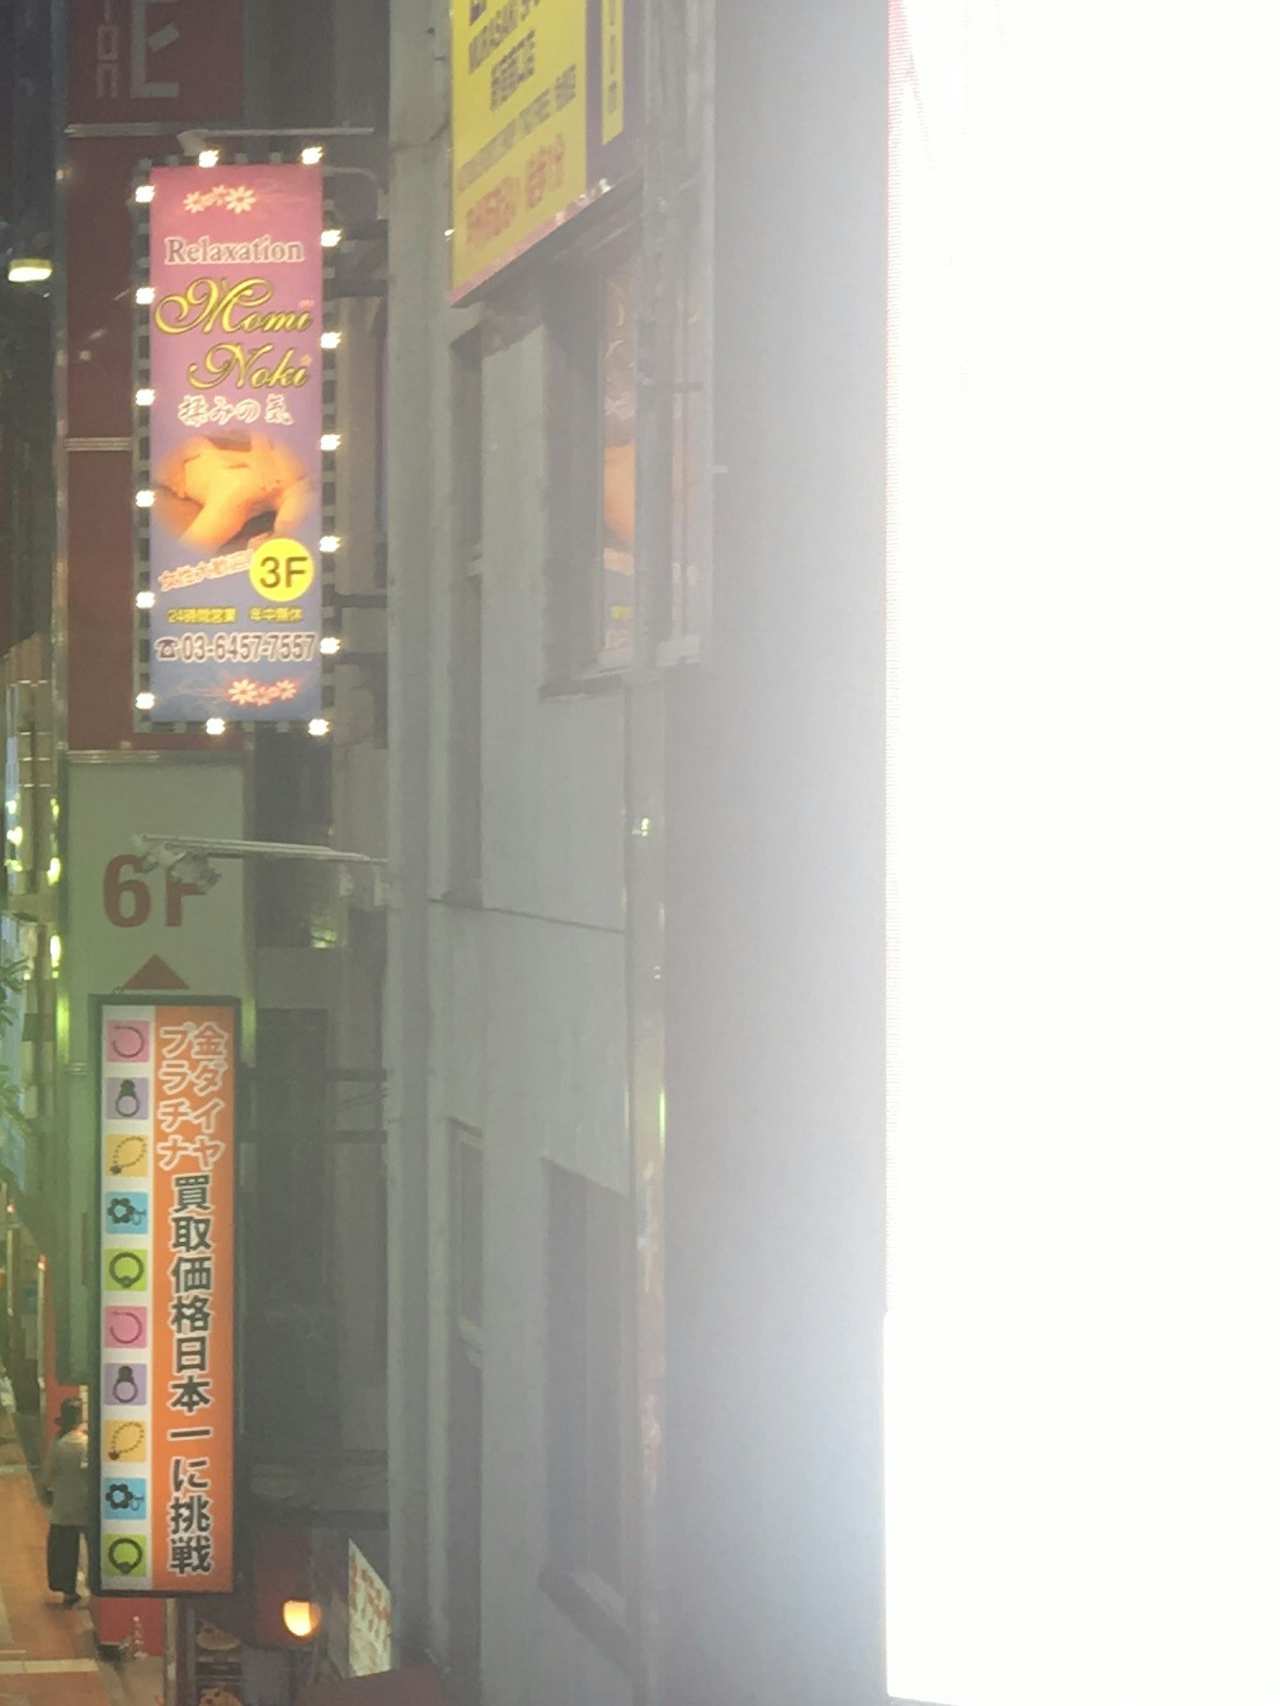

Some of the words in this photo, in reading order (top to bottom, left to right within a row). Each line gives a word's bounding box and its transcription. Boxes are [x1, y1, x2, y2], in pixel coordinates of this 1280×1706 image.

[164, 236, 305, 265] Relaxation
[155, 276, 314, 335] Momi
[187, 342, 312, 391] Noki
[258, 555, 309, 589] 3F
[181, 633, 316, 662] 03-6457-7557
[166, 1172, 214, 1577] 買取価格日本一に挑戦
